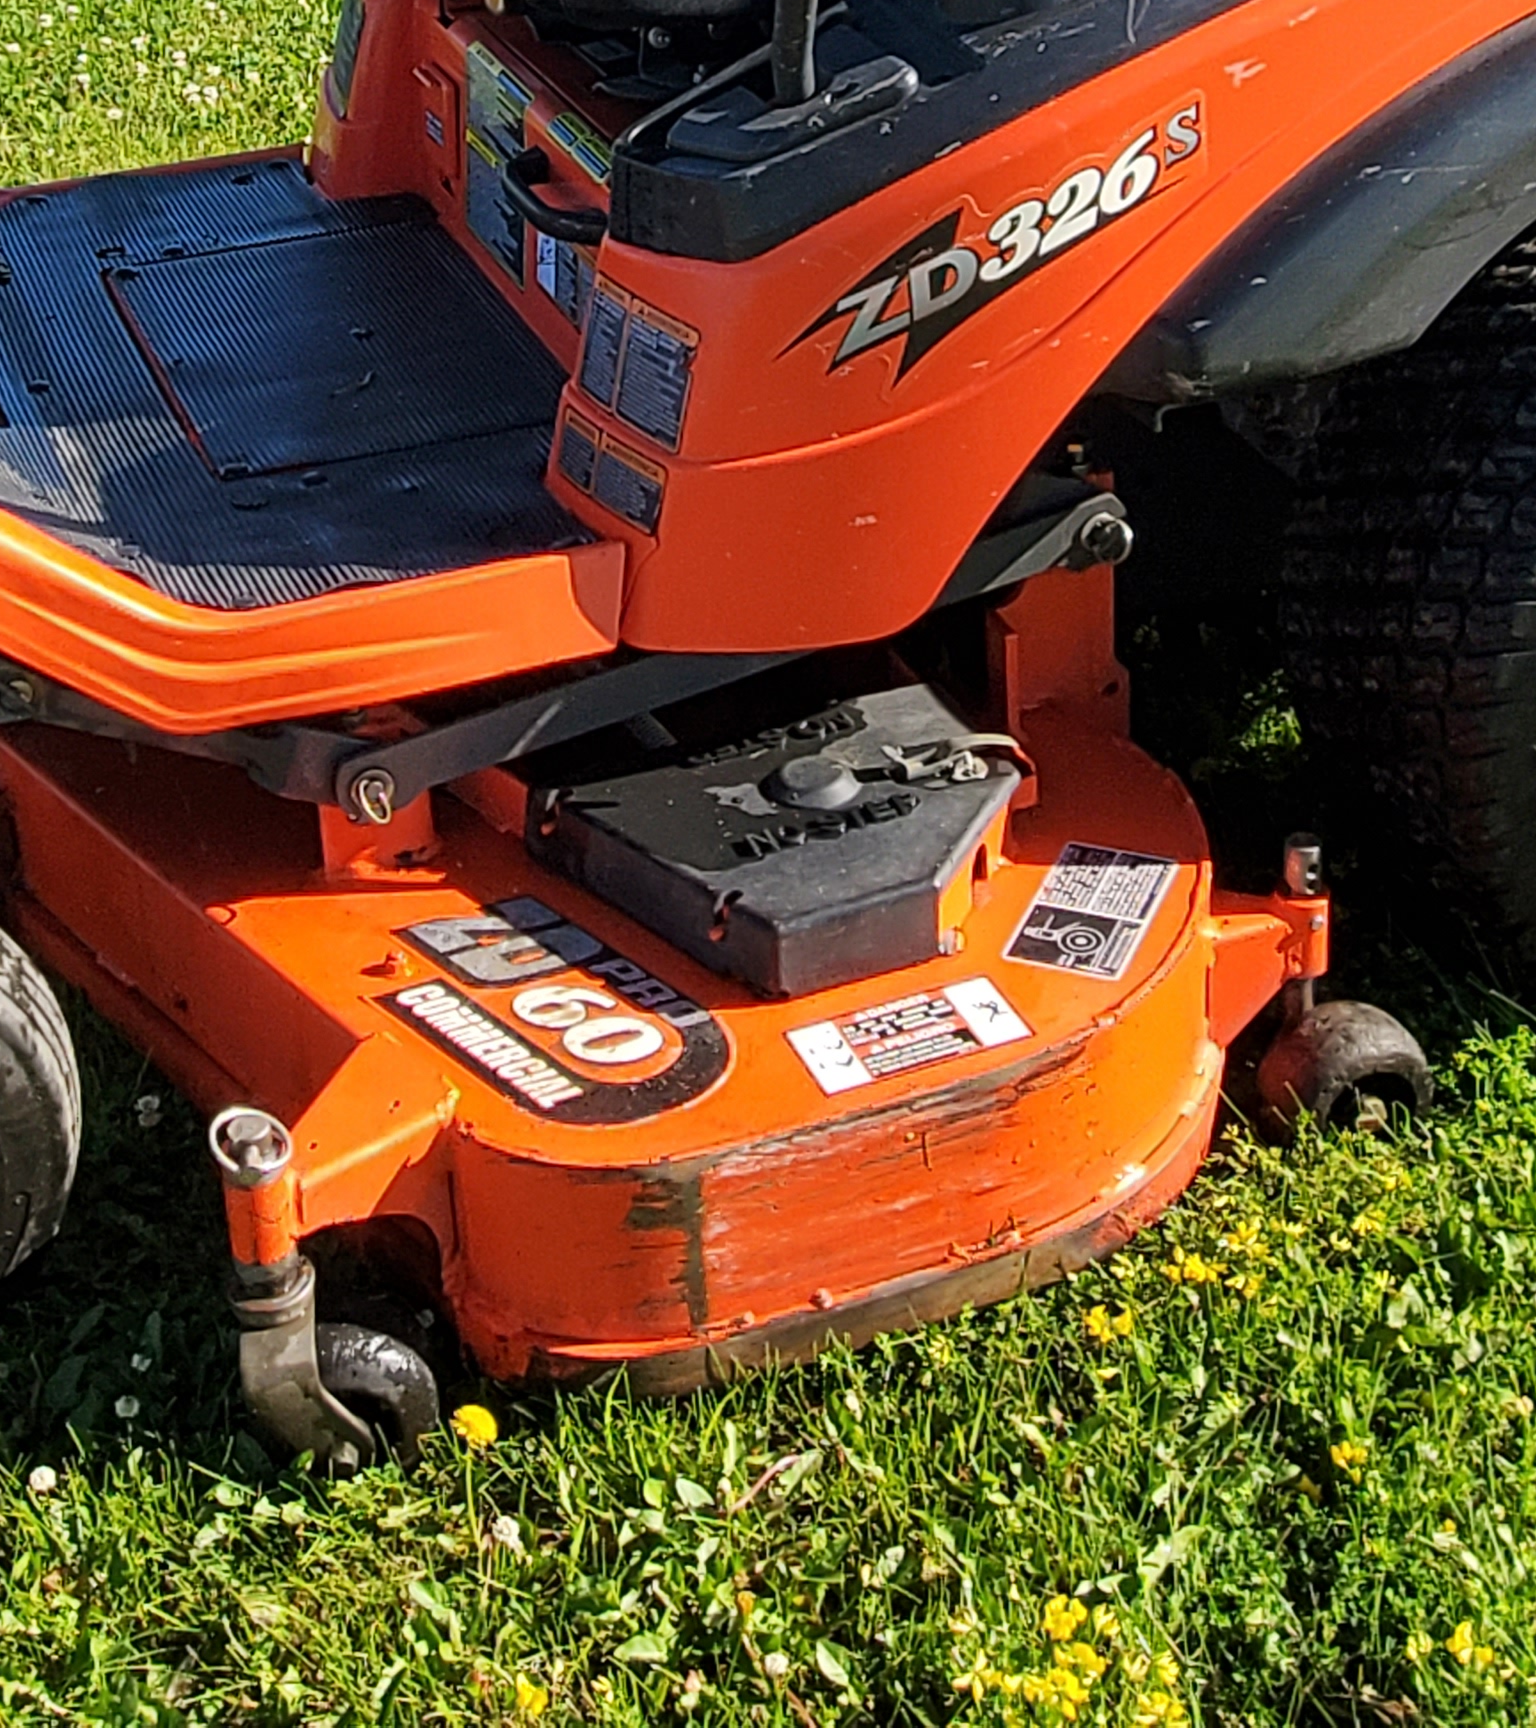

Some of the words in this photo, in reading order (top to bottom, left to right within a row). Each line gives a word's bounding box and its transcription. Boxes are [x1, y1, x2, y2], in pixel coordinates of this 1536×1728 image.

[511, 985, 664, 1063] 60
[590, 959, 711, 1028] PRO
[396, 984, 585, 1109] COMMERCIAL
